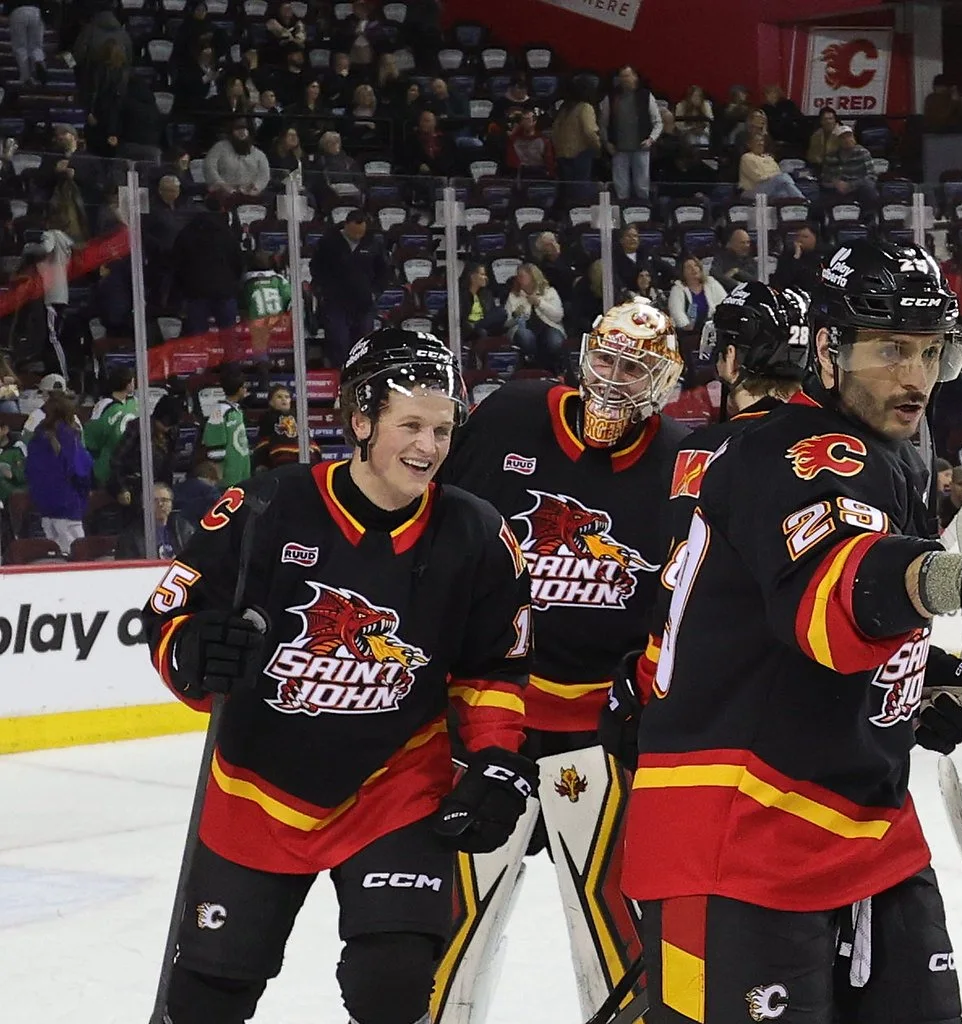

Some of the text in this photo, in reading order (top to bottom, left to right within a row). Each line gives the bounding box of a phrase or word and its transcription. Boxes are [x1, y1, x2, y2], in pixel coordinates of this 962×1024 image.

[837, 95, 876, 110] RED
[900, 297, 941, 307] CCM
[788, 325, 809, 345] 28
[416, 349, 450, 364] CCM
[506, 458, 535, 469] RUUD
[783, 496, 889, 561] 29
[284, 550, 316, 561] RUUD
[150, 560, 201, 614] 5
[271, 650, 403, 684] SAINT
[298, 681, 398, 708] JOHN
[443, 811, 468, 821] CCM
[362, 873, 443, 892] CCM
